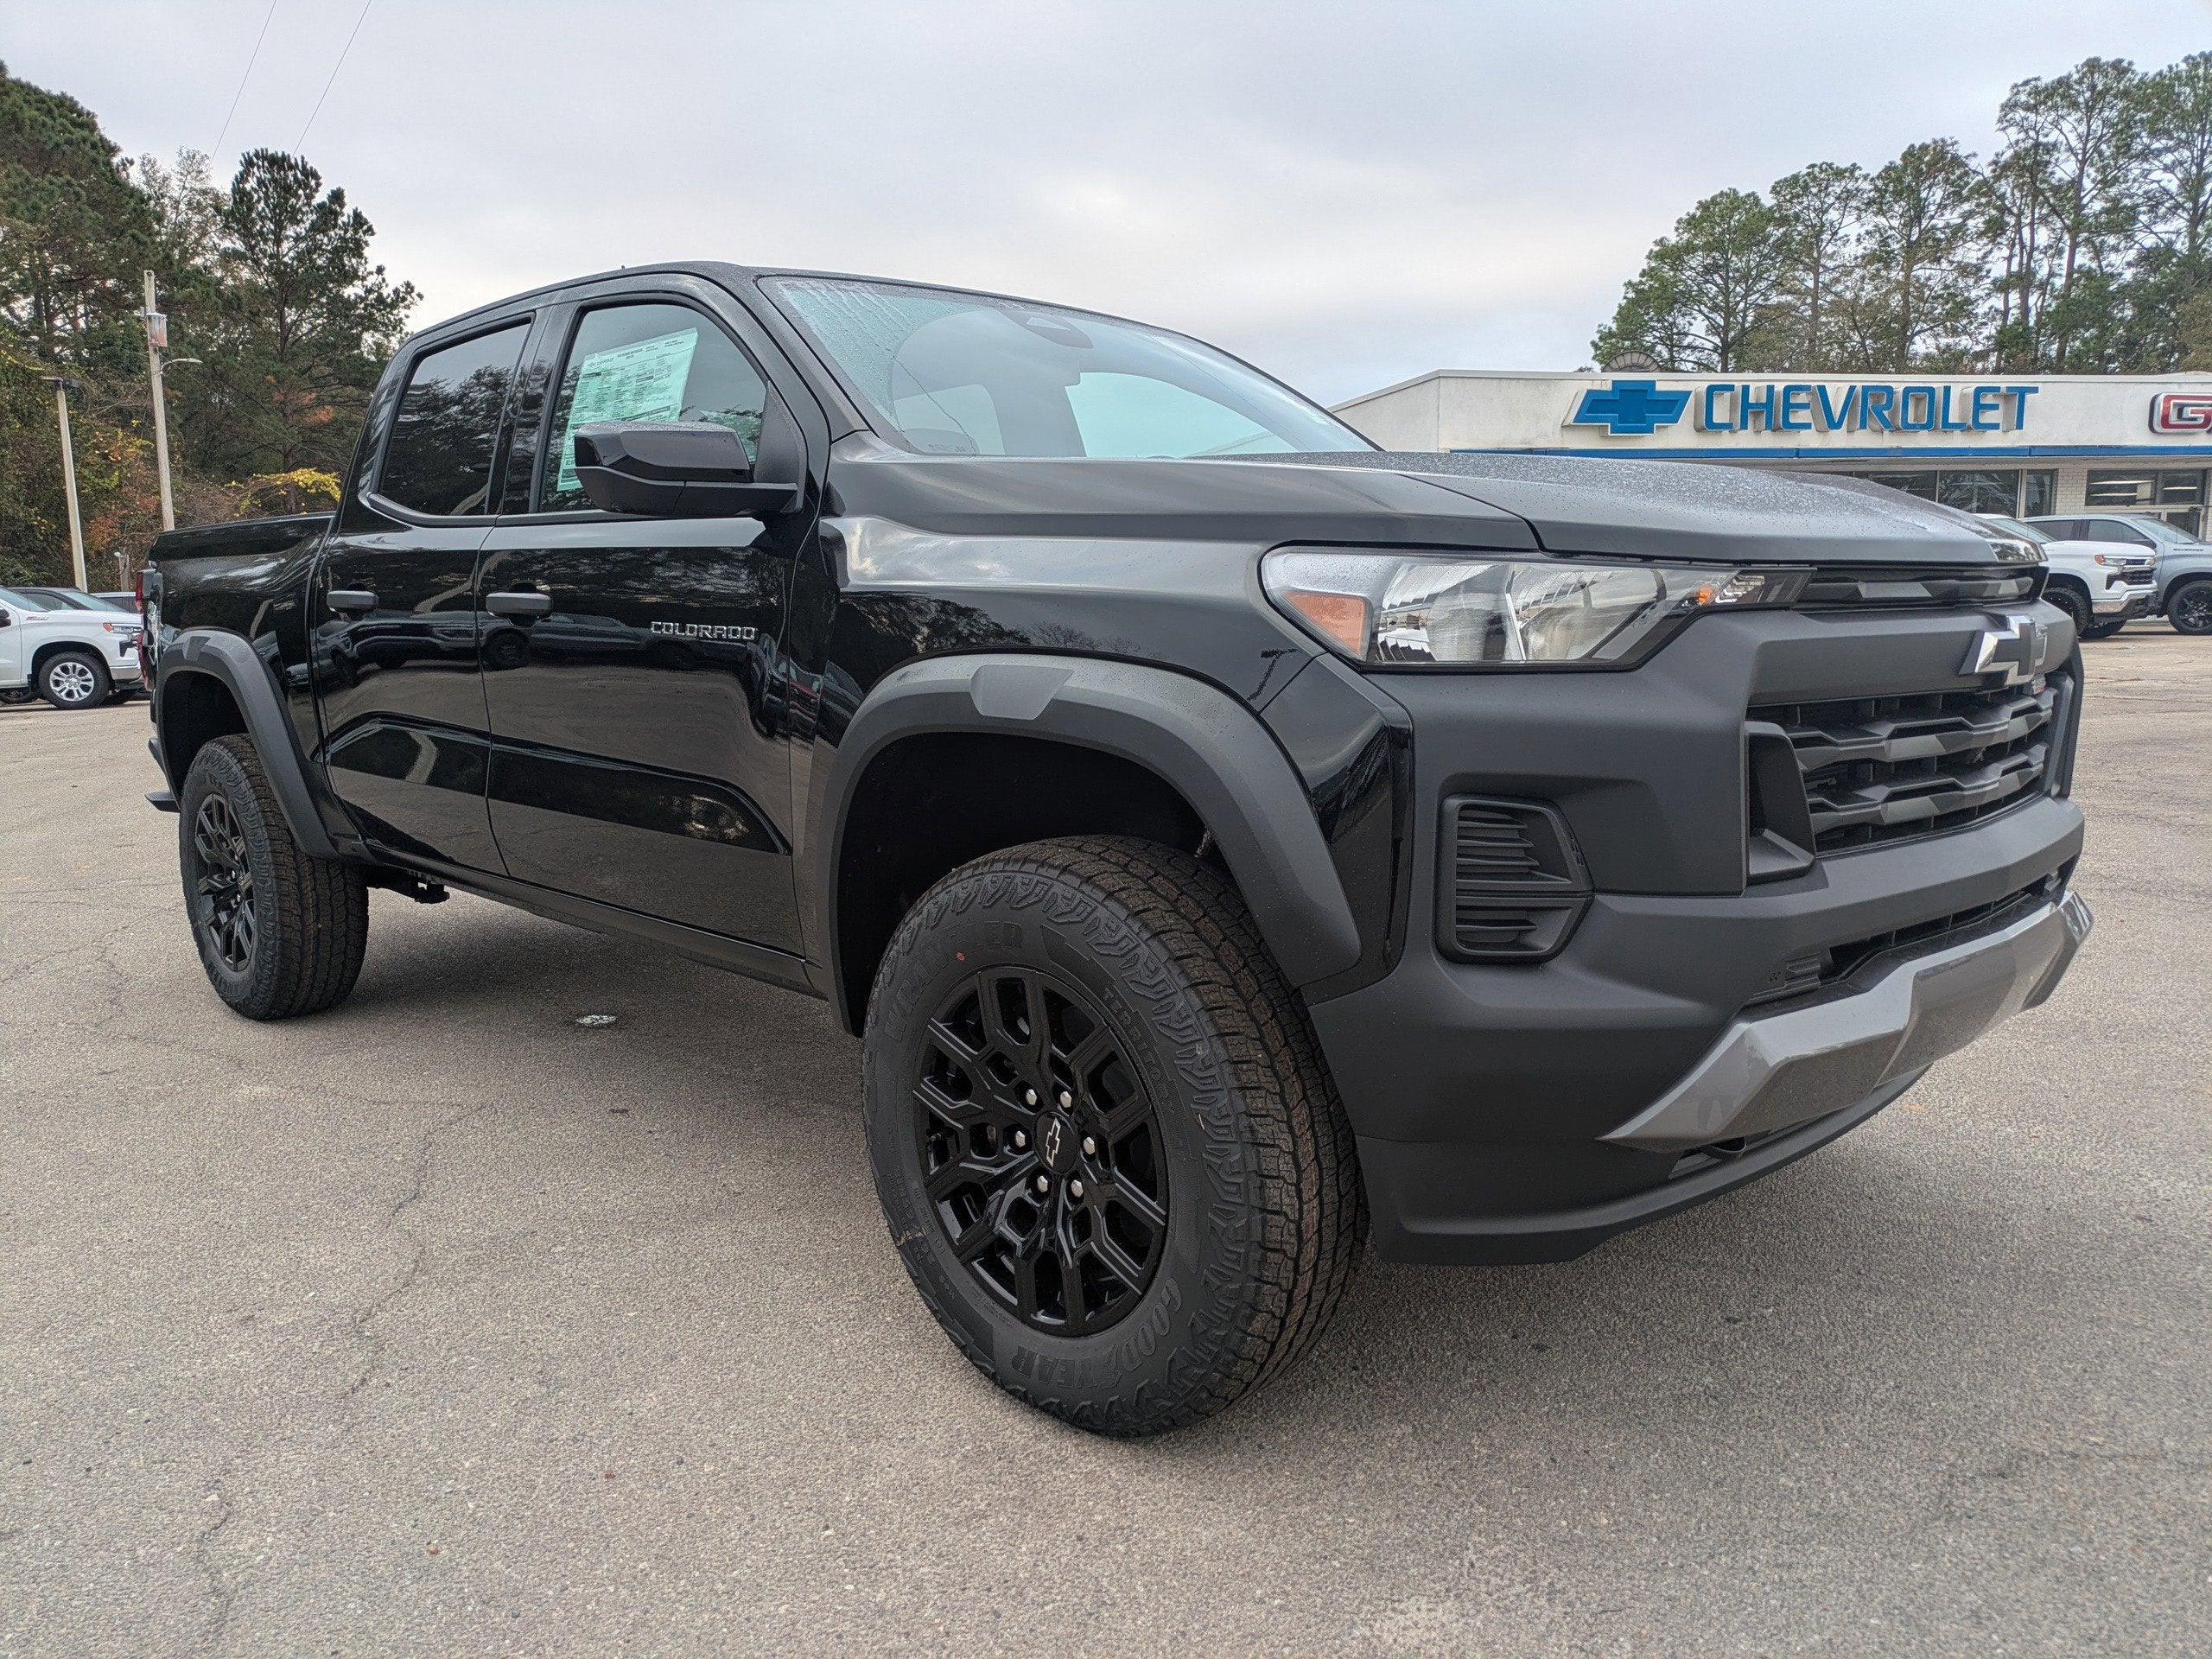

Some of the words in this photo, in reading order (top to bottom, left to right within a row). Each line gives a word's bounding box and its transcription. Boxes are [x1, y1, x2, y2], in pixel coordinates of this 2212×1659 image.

[1704, 384, 2040, 430] CHEVROLET
[650, 620, 757, 641] COLORADO
[1011, 1277, 1183, 1390] GOODYEAR
